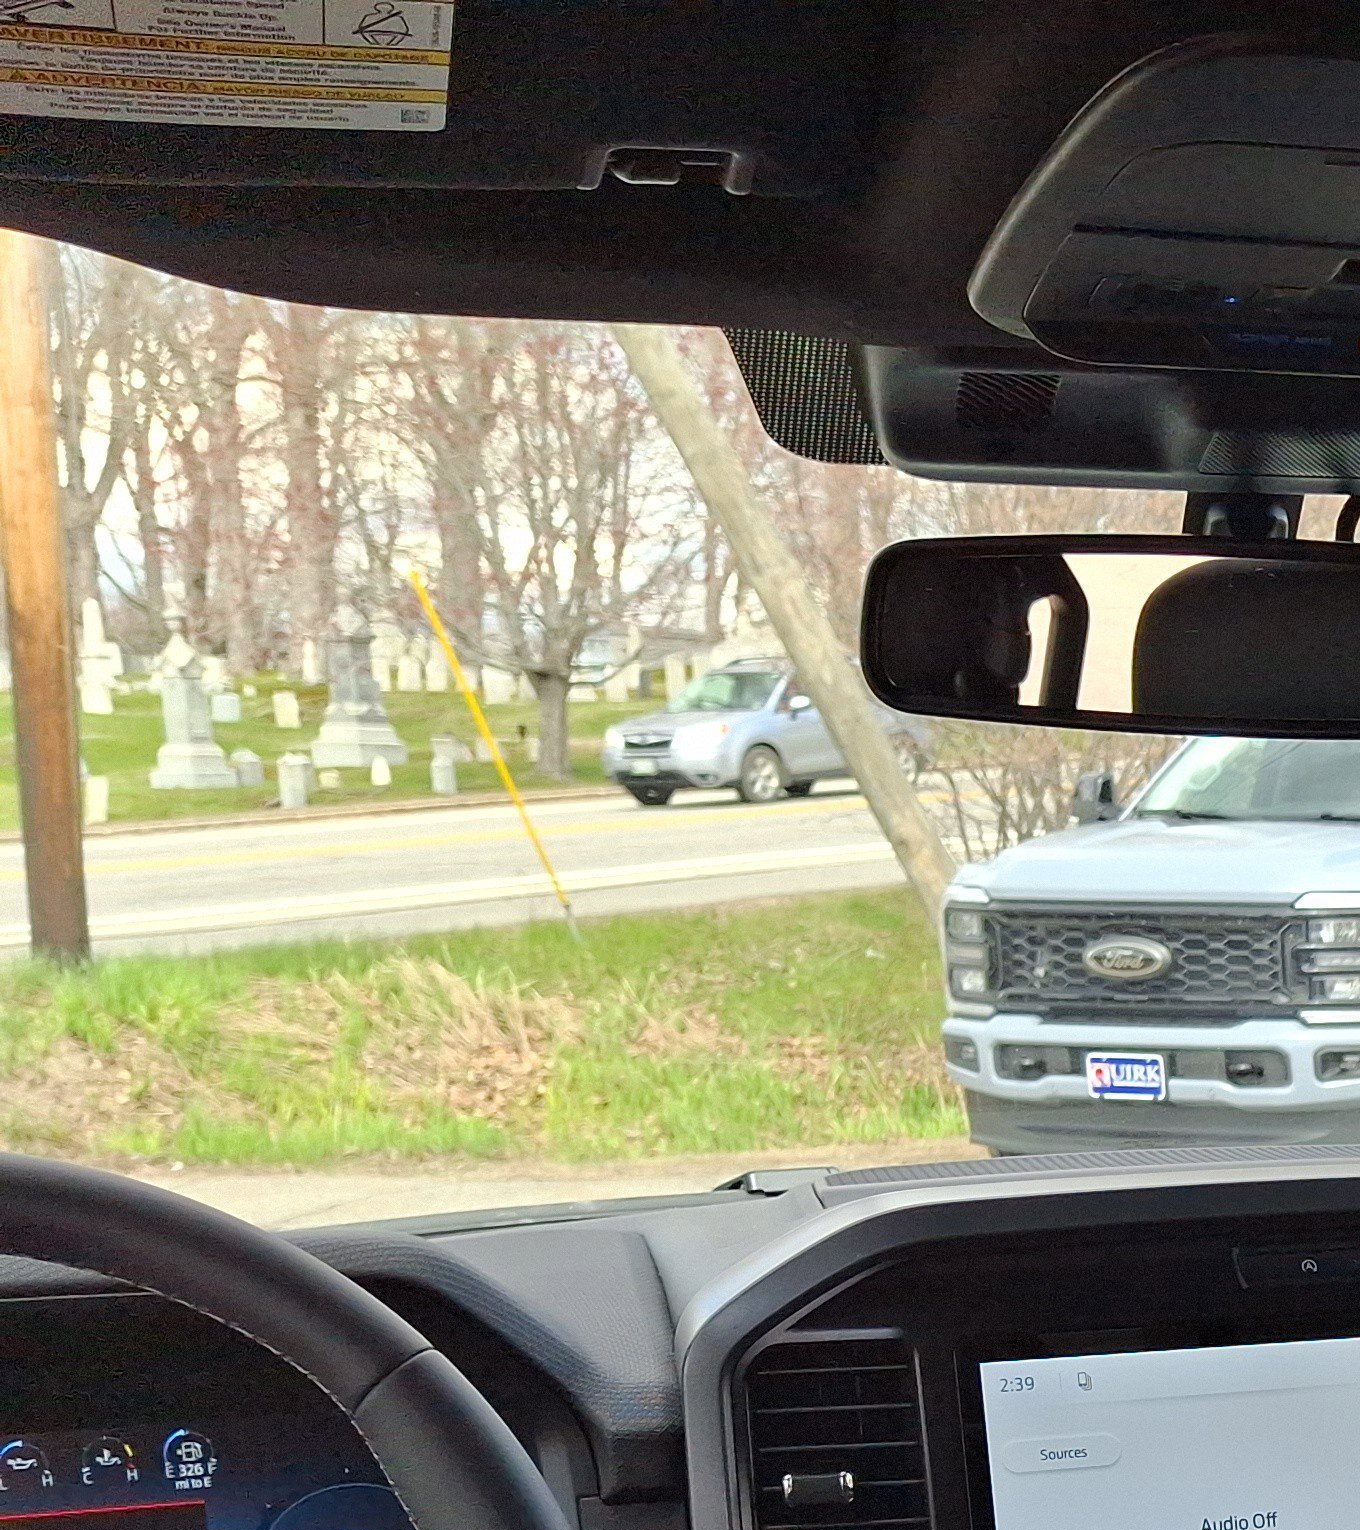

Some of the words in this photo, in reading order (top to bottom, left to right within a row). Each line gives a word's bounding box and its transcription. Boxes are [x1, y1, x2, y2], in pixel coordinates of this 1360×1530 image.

[1102, 949, 1144, 969] Ford
[1001, 1377, 1034, 1392] 2:39
[1041, 1448, 1088, 1461] Sources
[178, 1463, 204, 1476] 326
[176, 1479, 189, 1490] mi
[192, 1479, 201, 1488] to
[1253, 1512, 1277, 1528] Off
